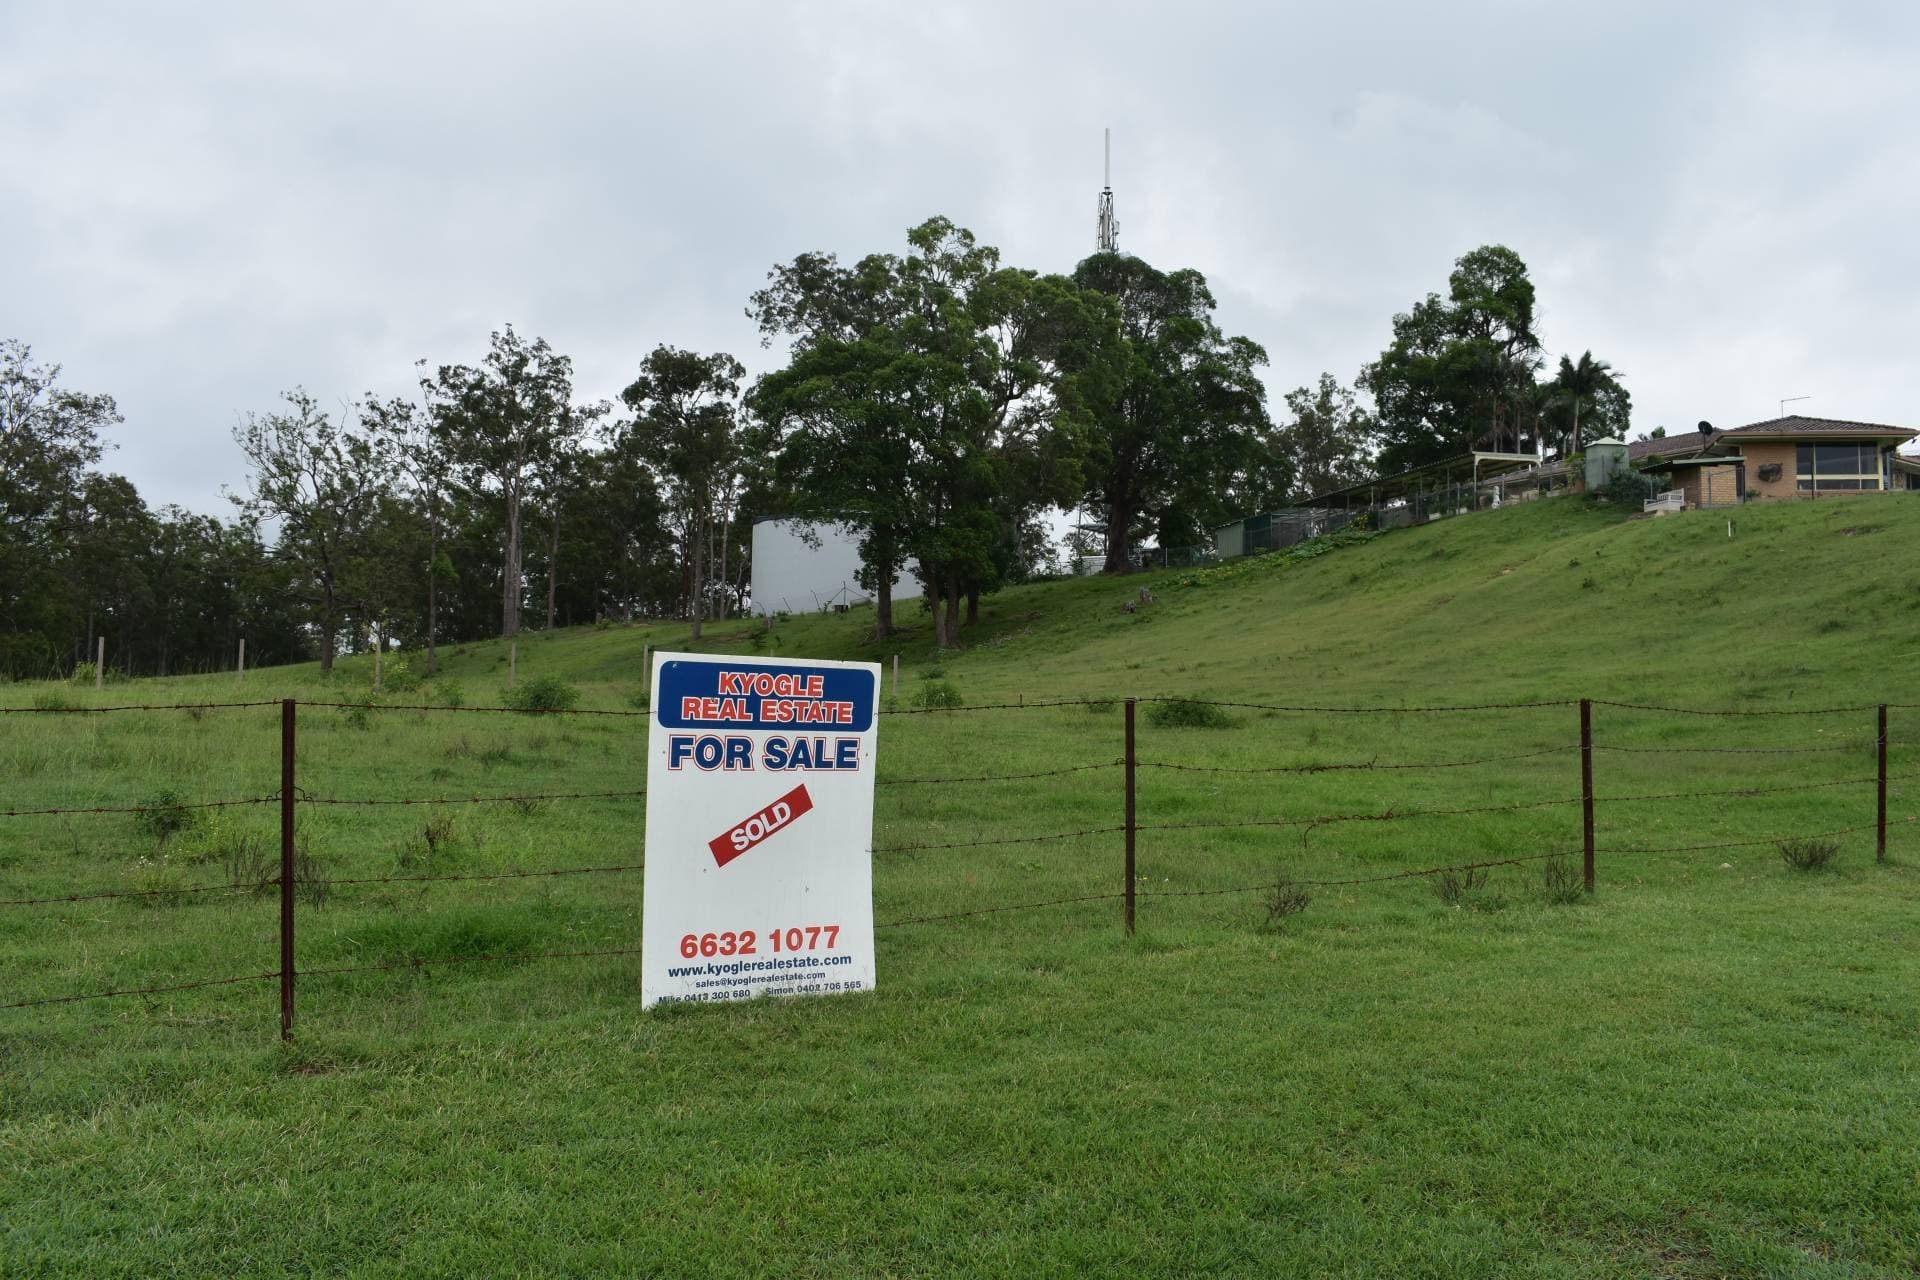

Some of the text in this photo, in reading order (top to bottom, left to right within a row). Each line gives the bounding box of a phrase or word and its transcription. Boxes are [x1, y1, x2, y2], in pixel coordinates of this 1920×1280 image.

[718, 671, 824, 698] KYOGLE
[682, 696, 853, 724] REAL ESTATE
[668, 734, 860, 771] FOR SALE
[730, 802, 791, 851] SOLD
[680, 925, 840, 959] 6632 1077
[668, 954, 852, 977] www.kyoglerealestate.com
[695, 971, 826, 988] sales@kyoglerealestate.com
[843, 980, 862, 989] 565
[711, 991, 730, 1000] 300
[732, 989, 751, 999] 680
